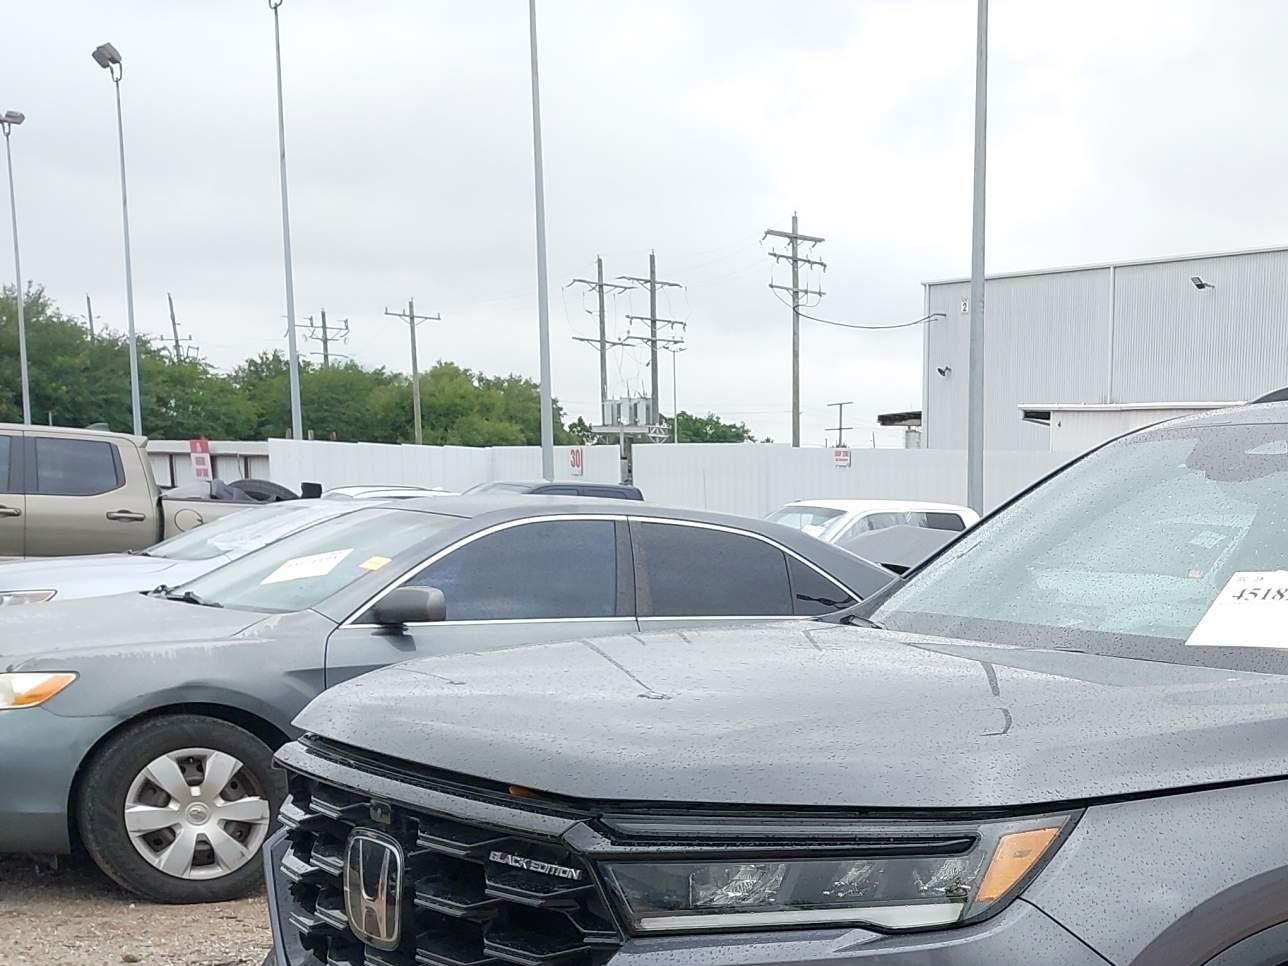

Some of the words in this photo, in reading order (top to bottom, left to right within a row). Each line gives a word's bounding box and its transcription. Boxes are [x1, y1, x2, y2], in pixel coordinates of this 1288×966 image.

[570, 449, 581, 468] 30
[489, 851, 528, 869] BLACK
[530, 861, 582, 880] EDITION
